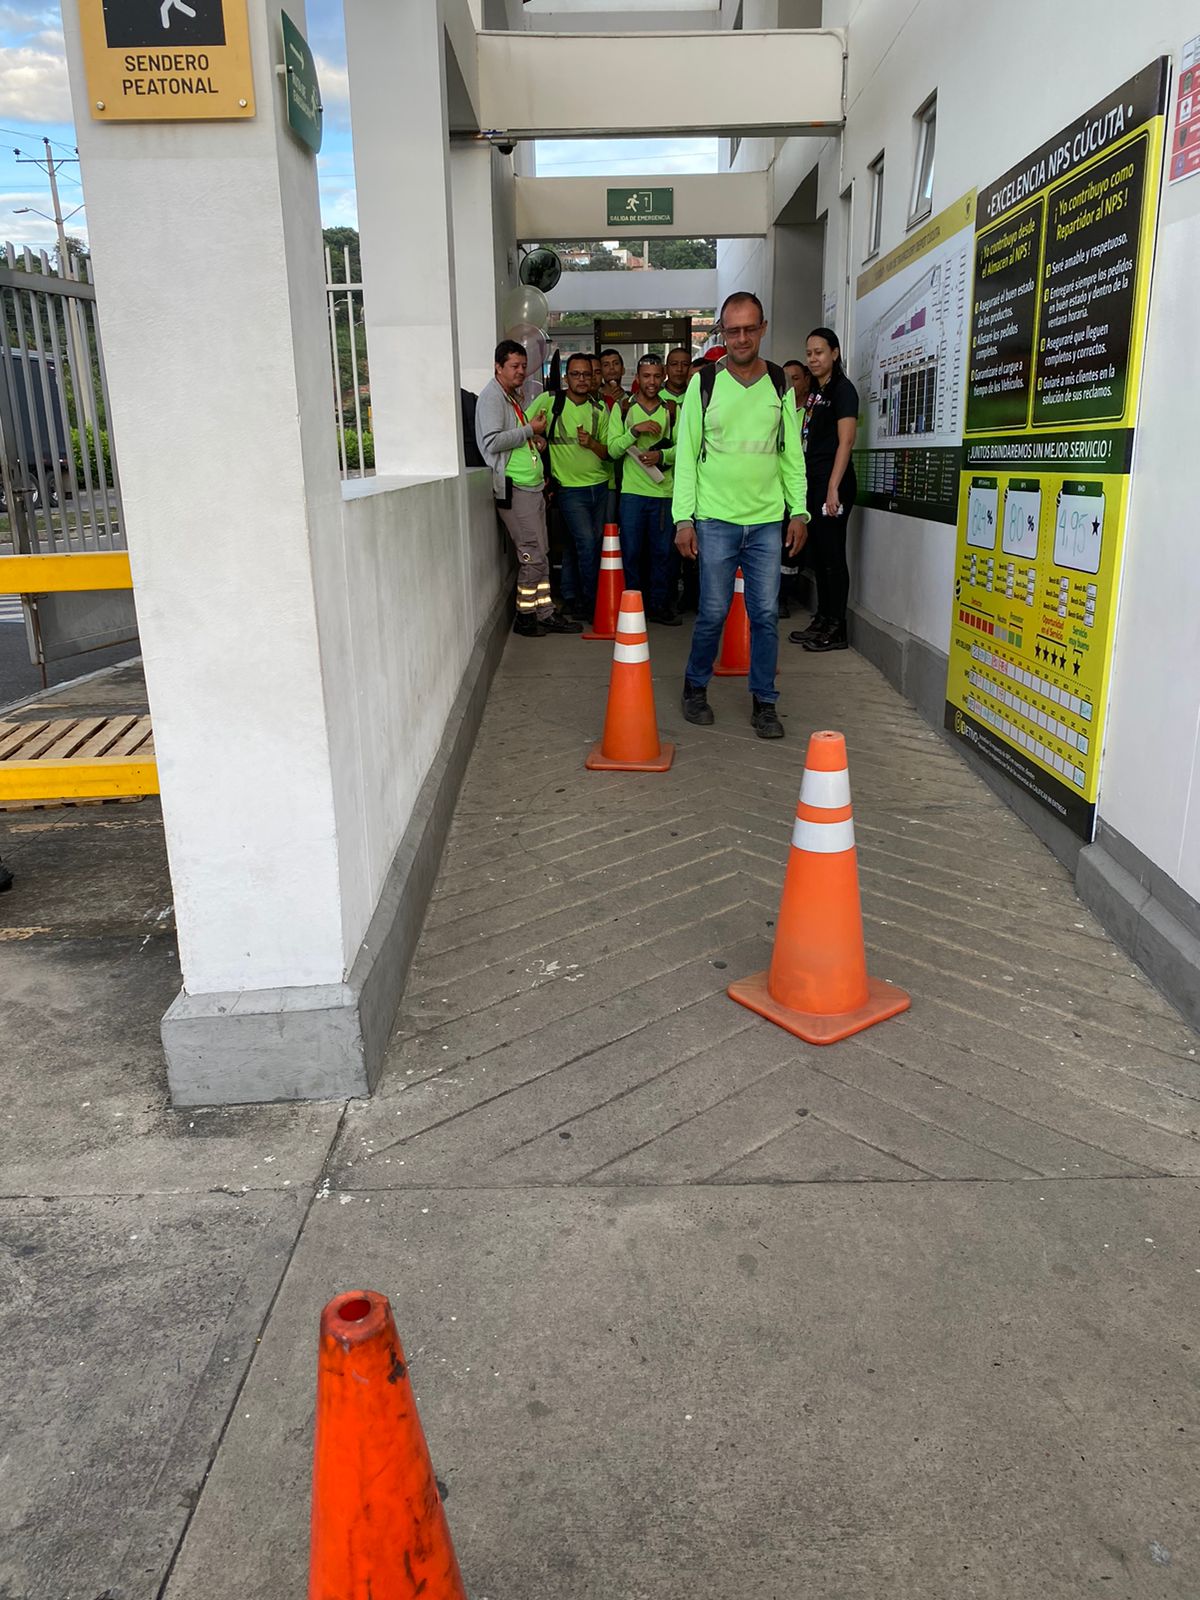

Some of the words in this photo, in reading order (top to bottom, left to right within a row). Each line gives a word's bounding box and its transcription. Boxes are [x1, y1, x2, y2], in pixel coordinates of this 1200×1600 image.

[124, 54, 210, 72] SENDERO
[122, 78, 220, 96] PEATONAL
[991, 161, 1045, 216] EXCELENCIA
[1048, 141, 1070, 179] NPS
[1073, 104, 1124, 161] CÚCUTA
[1059, 199, 1067, 216] Yo
[1068, 178, 1109, 210] contribuyo
[1110, 163, 1134, 187] como
[637, 214, 671, 222] EMERGENCIA
[1056, 209, 1094, 240] Repartidor
[1095, 199, 1104, 221] al
[1104, 190, 1123, 216] NPS
[983, 244, 990, 258] Yo
[990, 231, 1017, 255] contribuyo
[1018, 217, 1035, 239] desde
[981, 263, 987, 278] el
[1009, 248, 1015, 265] al
[1015, 242, 1027, 261] NPS
[1051, 258, 1064, 274] Seré
[1064, 249, 1085, 269] amable
[1084, 249, 1090, 264] y
[1090, 233, 1127, 257] respetuoso.
[1000, 289, 1005, 303] el
[1005, 288, 1017, 301] buen
[1017, 278, 1034, 296] estado
[1050, 279, 1074, 301] Entregaré
[1074, 274, 1097, 290] siempre
[1097, 268, 1107, 281] los
[1107, 258, 1132, 281] pedidos
[1048, 304, 1055, 314] en
[1055, 296, 1068, 312] buen
[1069, 289, 1087, 307] estado
[1087, 291, 1092, 304] y
[1092, 280, 1112, 299] dentro
[1112, 277, 1121, 292] de
[1121, 274, 1128, 288] la
[977, 316, 983, 328] de
[999, 322, 1018, 341] pedidos
[1047, 314, 1067, 328] ventana
[1046, 331, 1073, 351] Aseguraré
[1073, 331, 1085, 345] que
[1085, 324, 1108, 341] lleguen
[1044, 350, 1072, 366] completos
[1071, 350, 1076, 364] y
[1076, 343, 1106, 359] correctos.
[997, 362, 1004, 375] el
[1003, 362, 1019, 376] cargue
[1019, 361, 1023, 370] a
[1043, 374, 1060, 389] Guiaré
[1060, 377, 1064, 386] a
[1064, 371, 1075, 385] mis
[1075, 369, 1098, 383] clientes
[1099, 368, 1107, 379] en
[1108, 363, 1115, 378] la
[987, 381, 994, 394] de
[1042, 390, 1064, 405] solución
[1064, 388, 1072, 402] de
[1072, 390, 1082, 401] sus
[1083, 384, 1112, 399] reclamos.
[990, 443, 1032, 458] BRINDAREMOS
[1032, 443, 1043, 458] UN
[1044, 442, 1069, 458] MEJOR
[1070, 440, 1107, 457] SERVICIO
[1009, 503, 1025, 543] 80
[1073, 625, 1088, 639] Servicio
